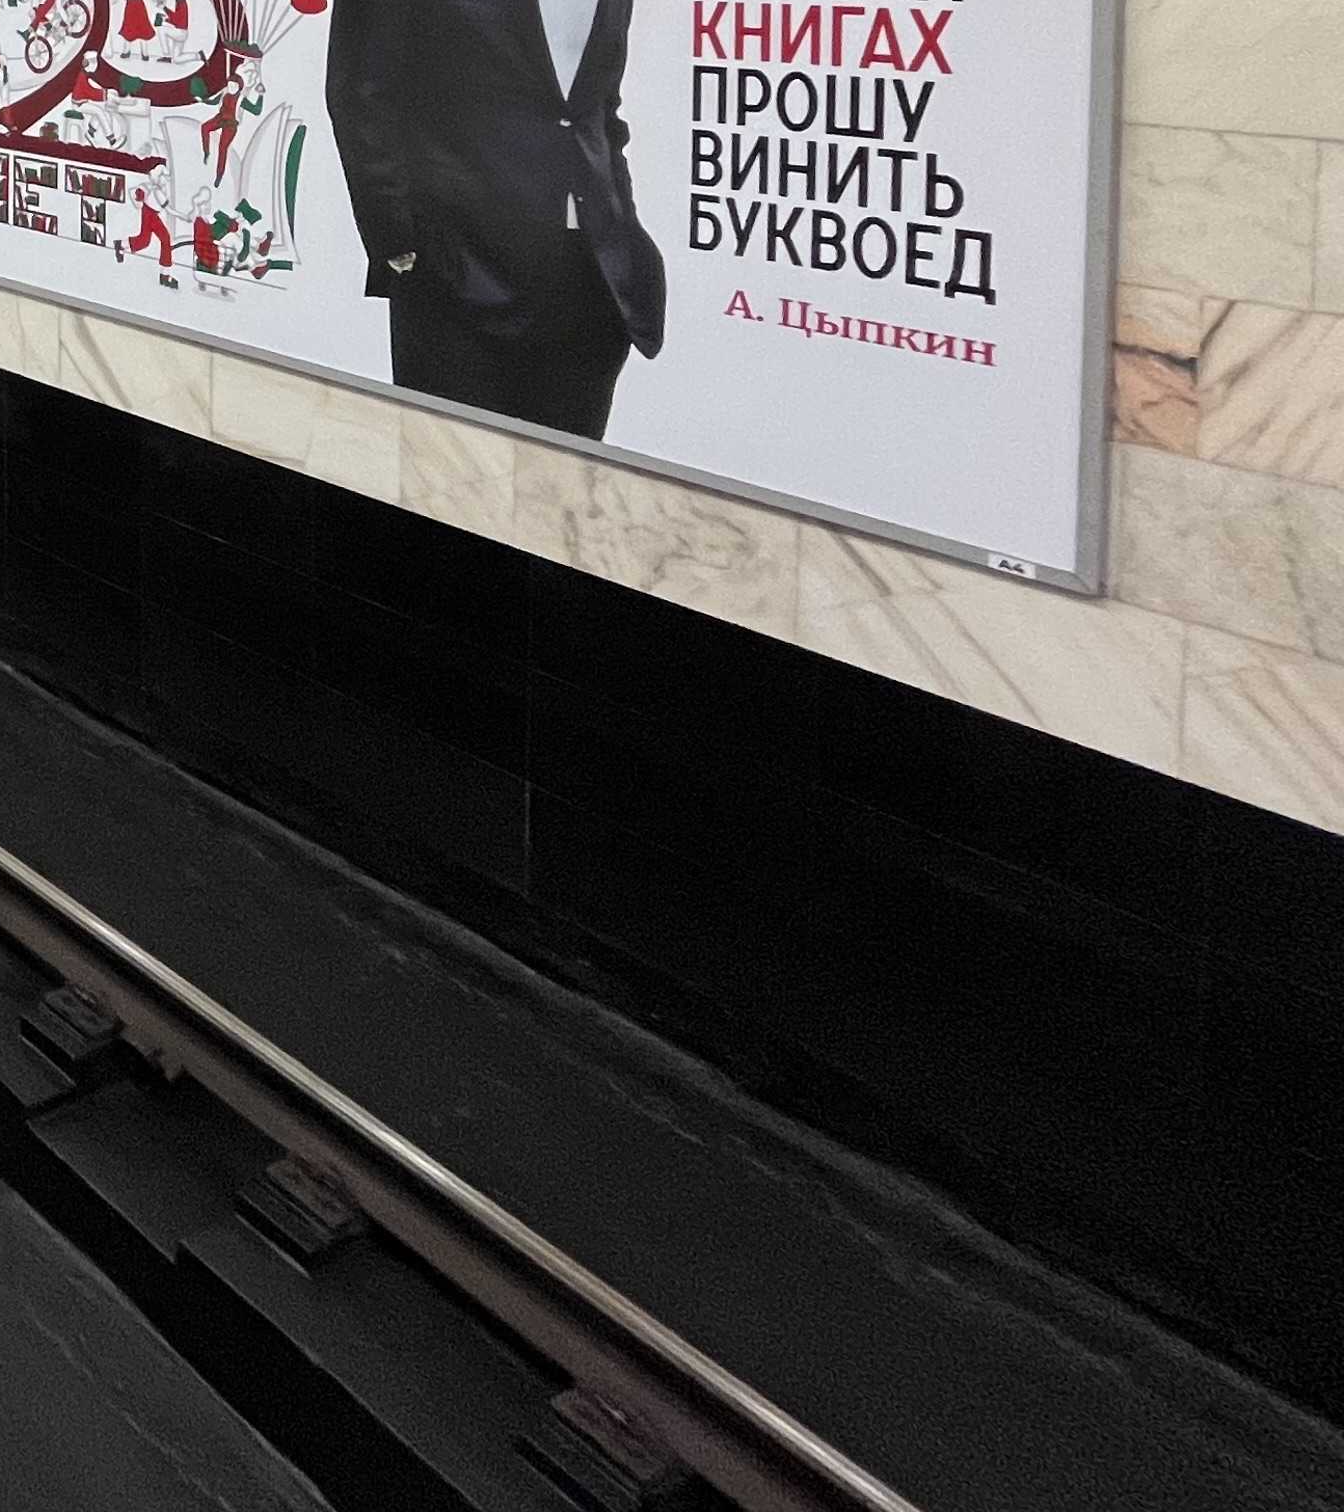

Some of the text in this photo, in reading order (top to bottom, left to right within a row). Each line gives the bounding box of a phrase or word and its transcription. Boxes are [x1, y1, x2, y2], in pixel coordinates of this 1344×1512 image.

[693, 1, 953, 75] КНИГАХ
[692, 65, 935, 142] ПРОШУ
[691, 129, 964, 217] ВИНИТЬ
[689, 193, 996, 305] БУКВОЕД
[723, 289, 998, 367] А. Цыпкин
